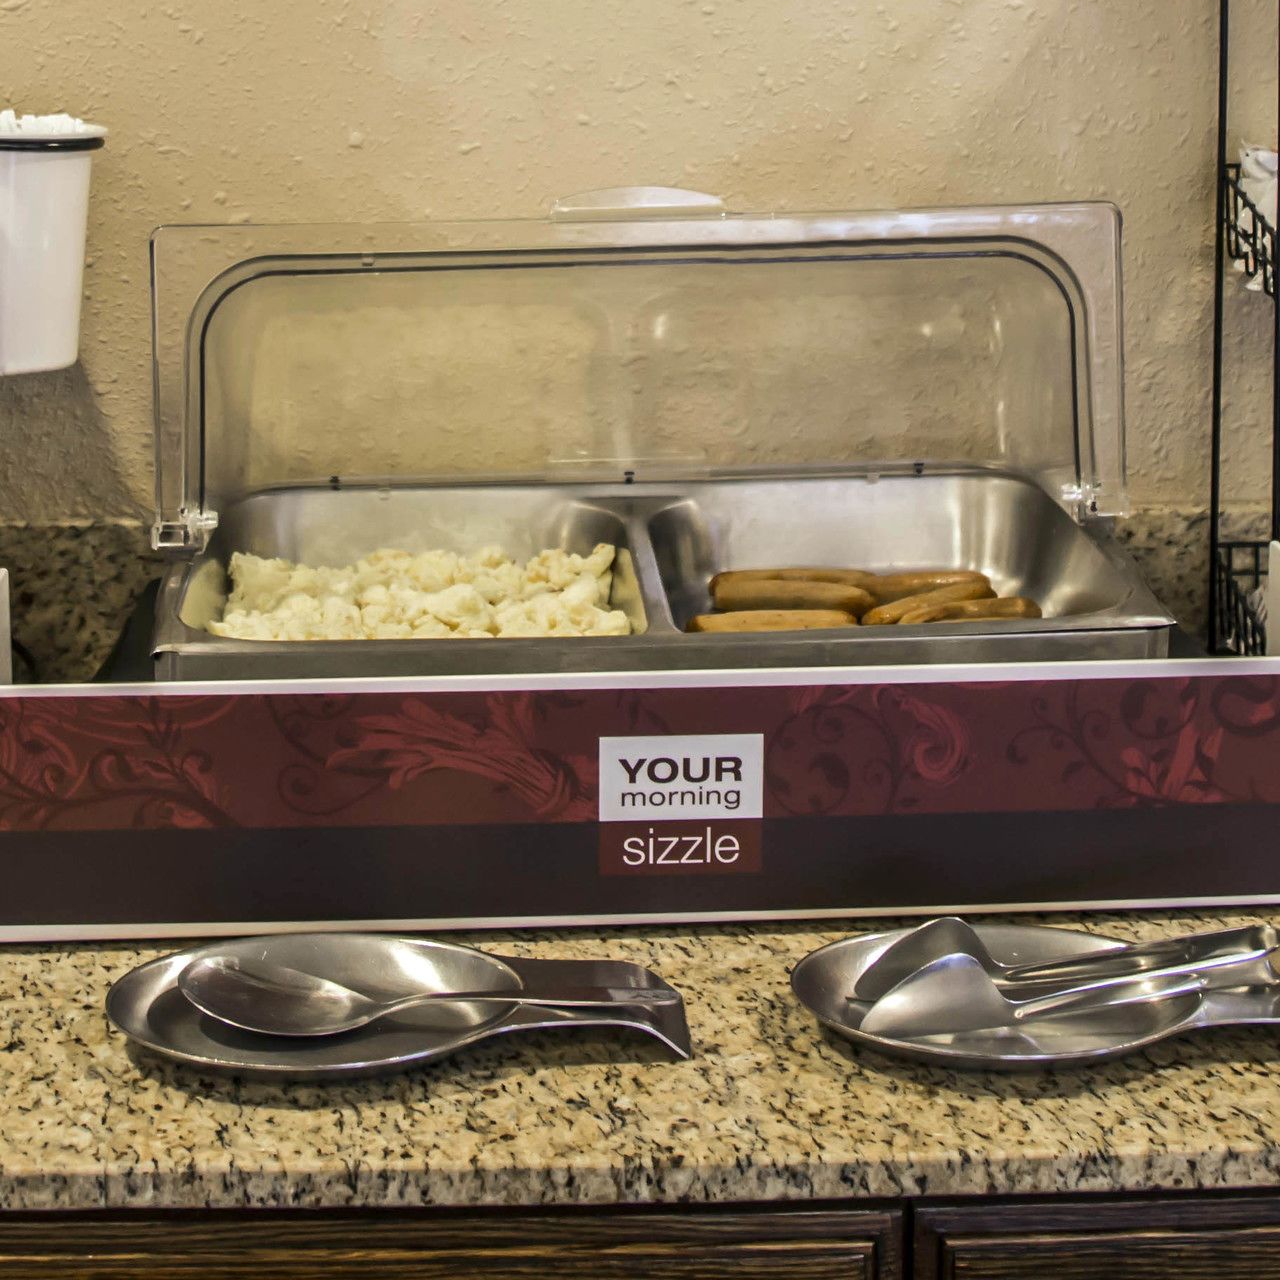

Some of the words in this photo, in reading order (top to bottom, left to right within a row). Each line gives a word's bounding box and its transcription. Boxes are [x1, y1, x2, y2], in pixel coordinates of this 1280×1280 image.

[618, 756, 743, 784] YOUR
[621, 785, 741, 810] morning
[622, 826, 740, 866] sizzle
